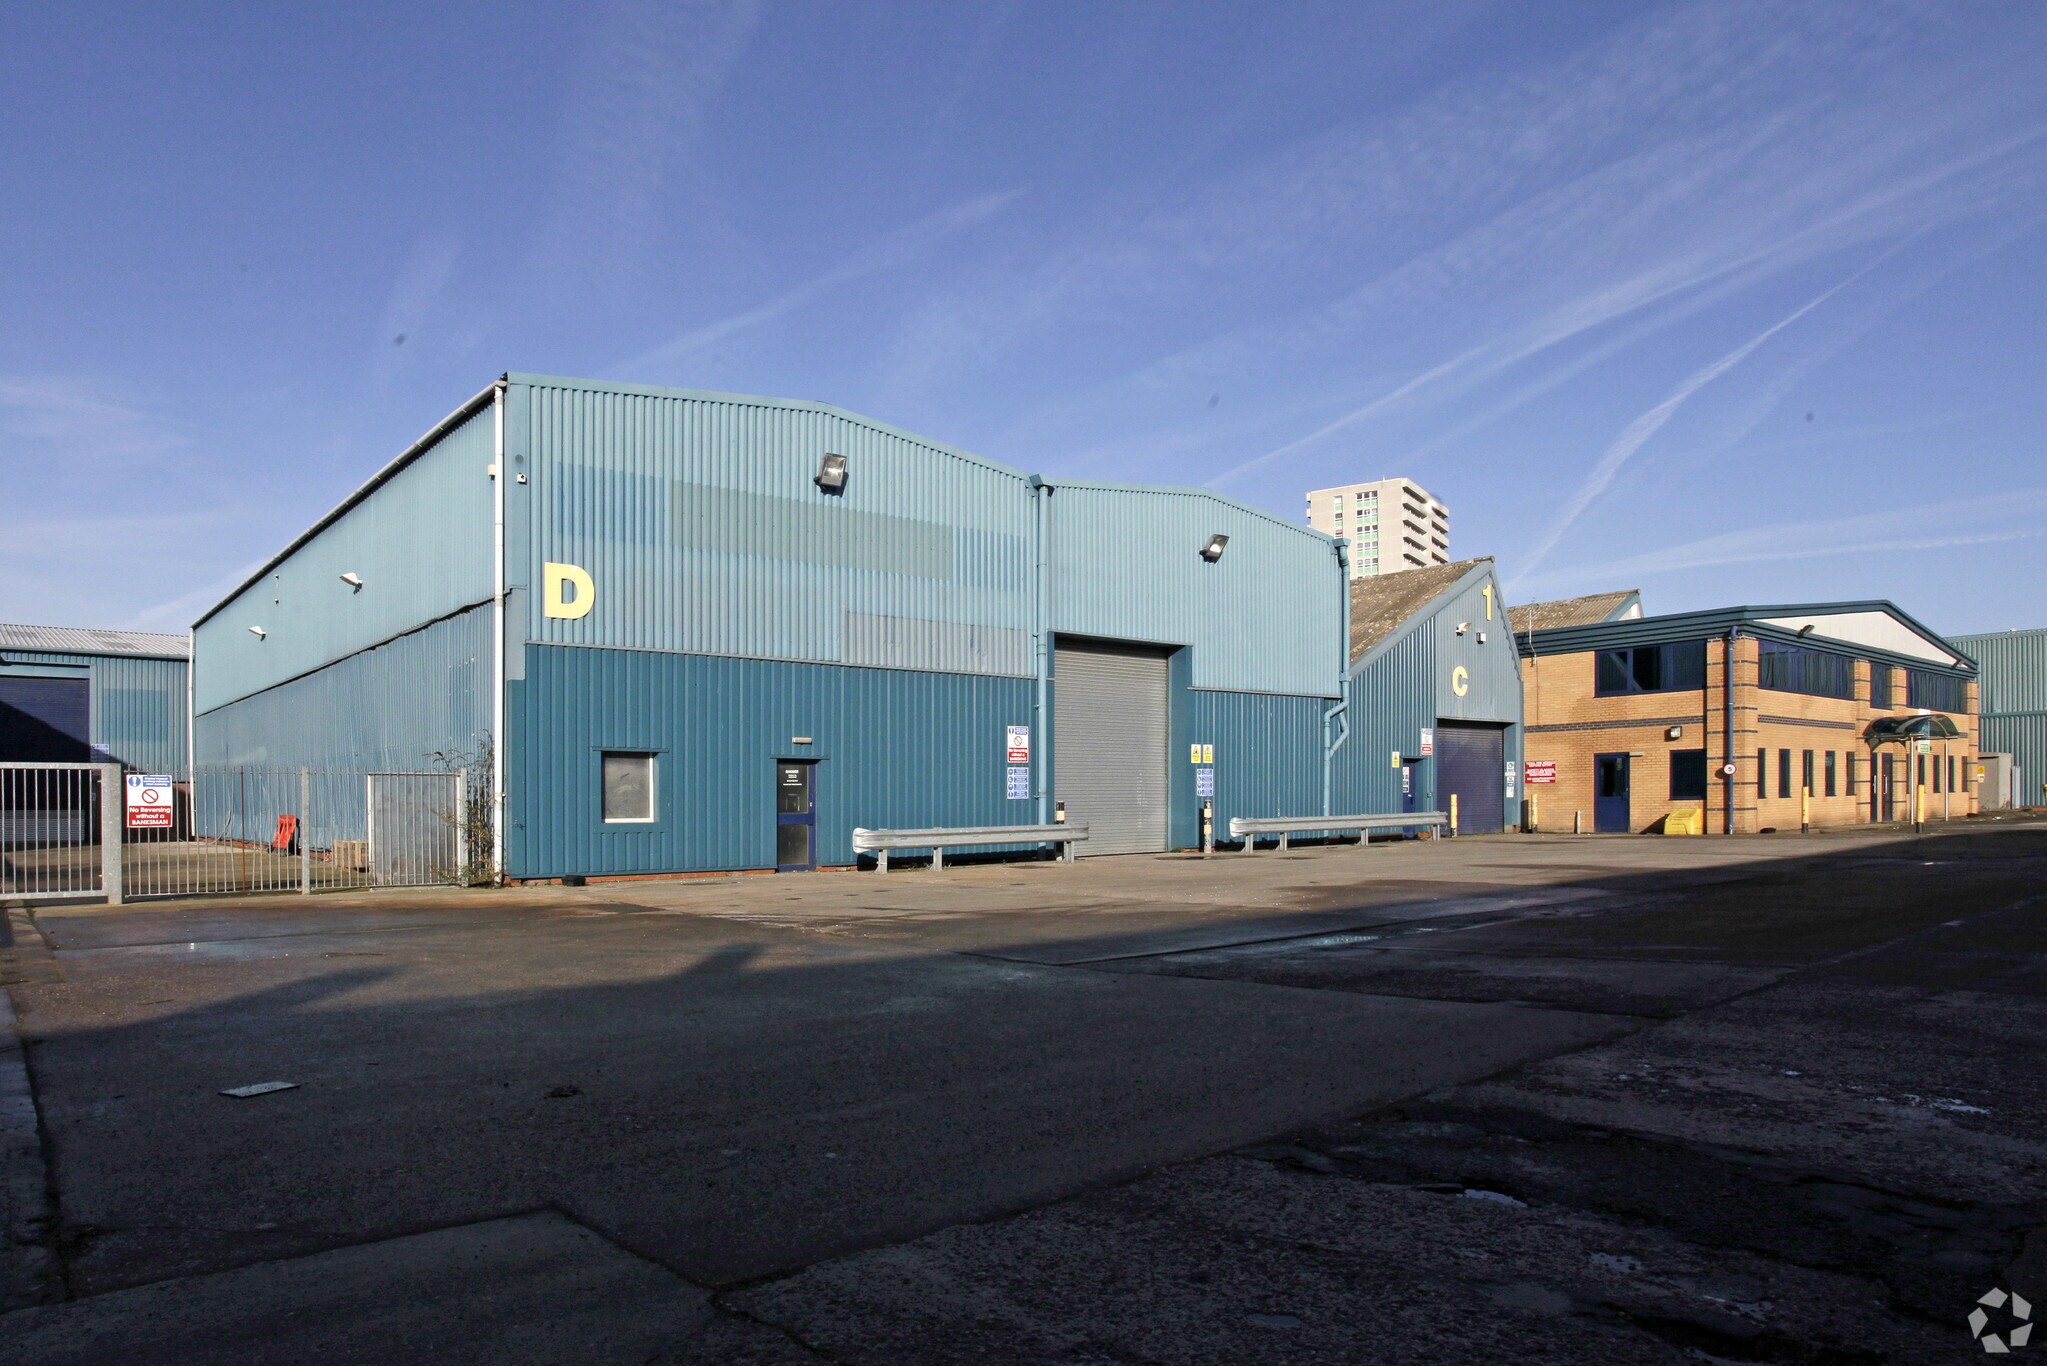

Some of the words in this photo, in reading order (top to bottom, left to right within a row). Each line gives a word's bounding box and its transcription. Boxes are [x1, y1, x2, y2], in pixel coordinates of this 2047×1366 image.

[544, 562, 595, 620] D
[1482, 584, 1492, 621] 1
[1452, 666, 1468, 697] C
